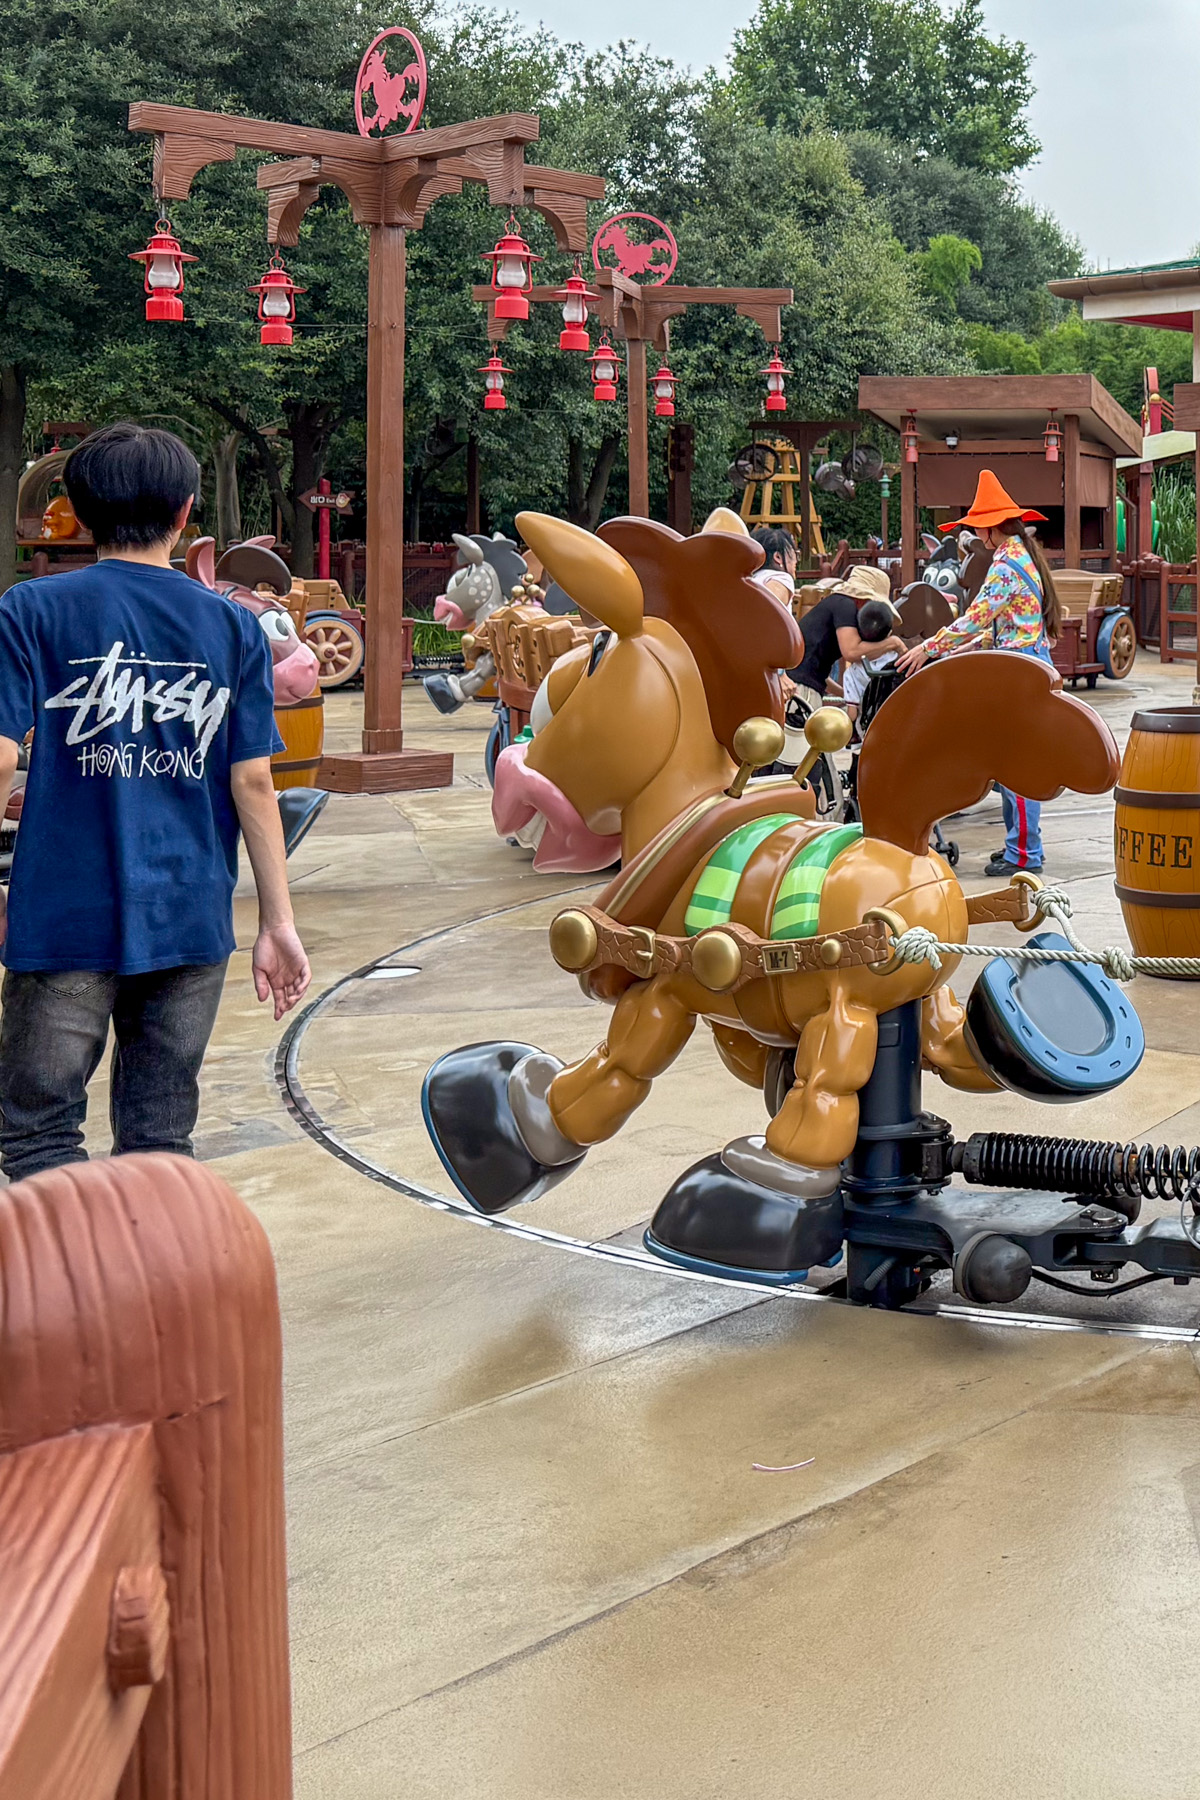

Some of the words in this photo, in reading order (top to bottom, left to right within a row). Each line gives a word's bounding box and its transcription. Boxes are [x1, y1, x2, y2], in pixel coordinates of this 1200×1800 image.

[77, 742, 137, 778] HONG
[139, 745, 205, 779] KONG
[769, 950, 789, 969] M-7
